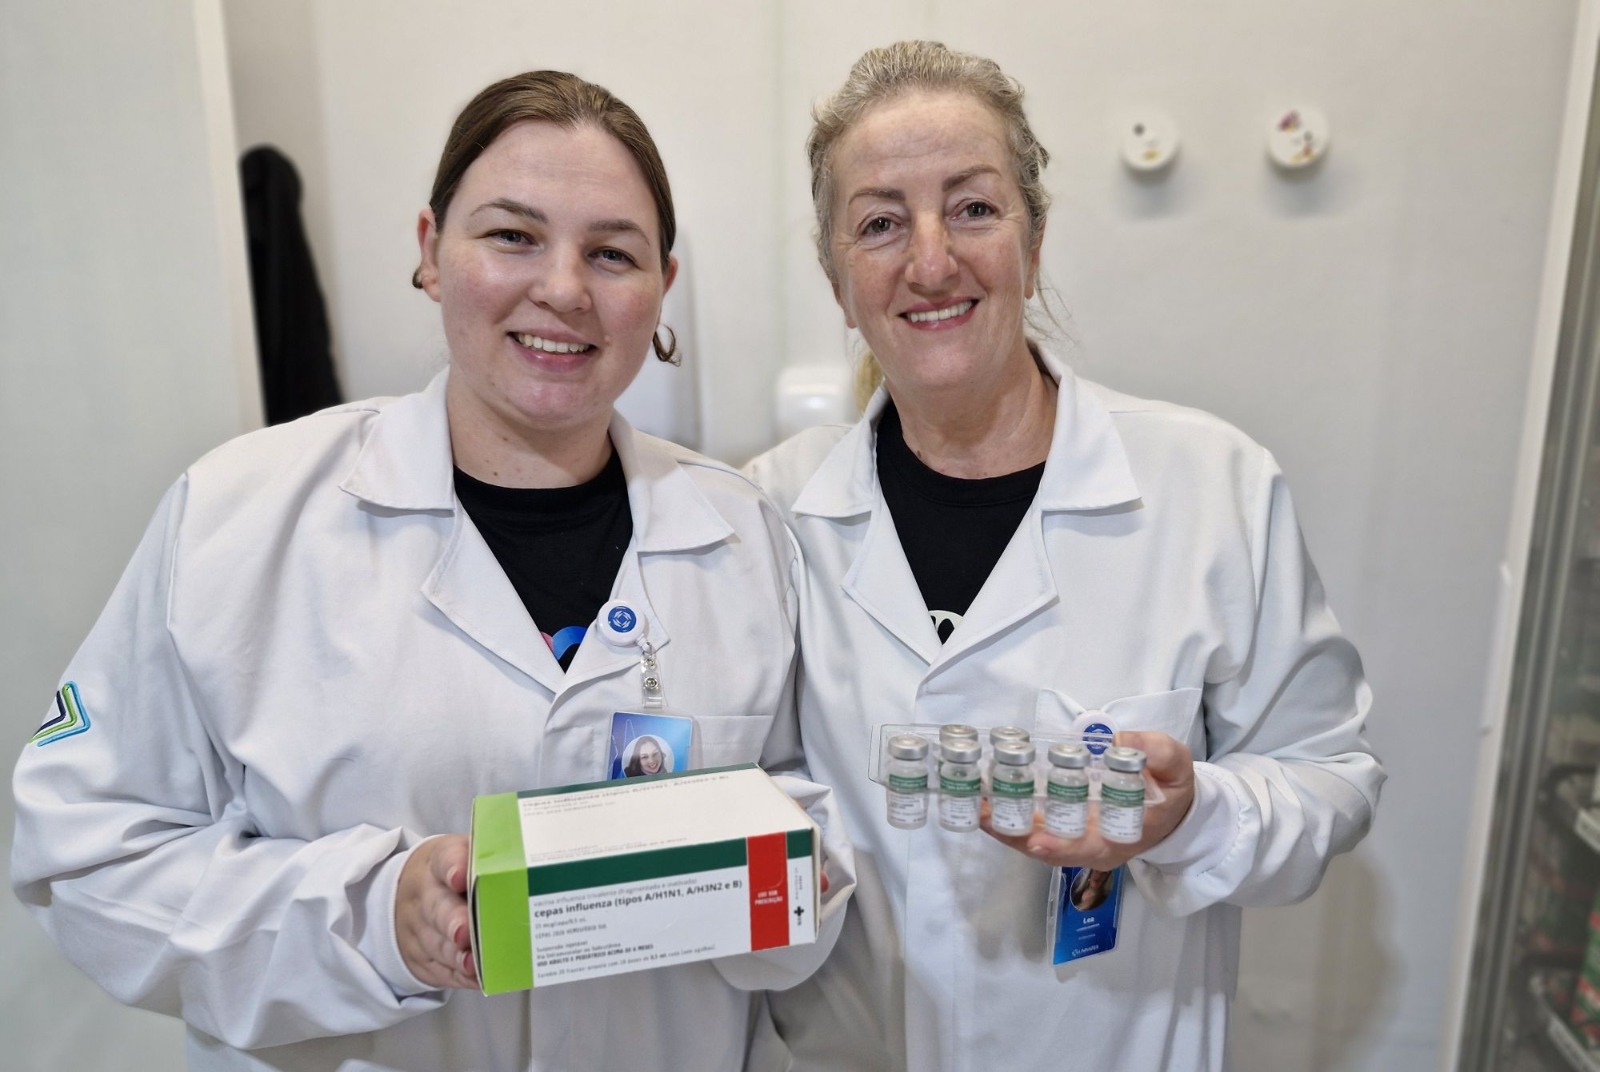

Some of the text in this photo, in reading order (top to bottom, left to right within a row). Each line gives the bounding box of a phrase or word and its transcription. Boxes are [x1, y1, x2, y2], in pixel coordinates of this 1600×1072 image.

[534, 879, 743, 918] cepas influenza (tipos A/H1N1, A/H3N2 e B)
